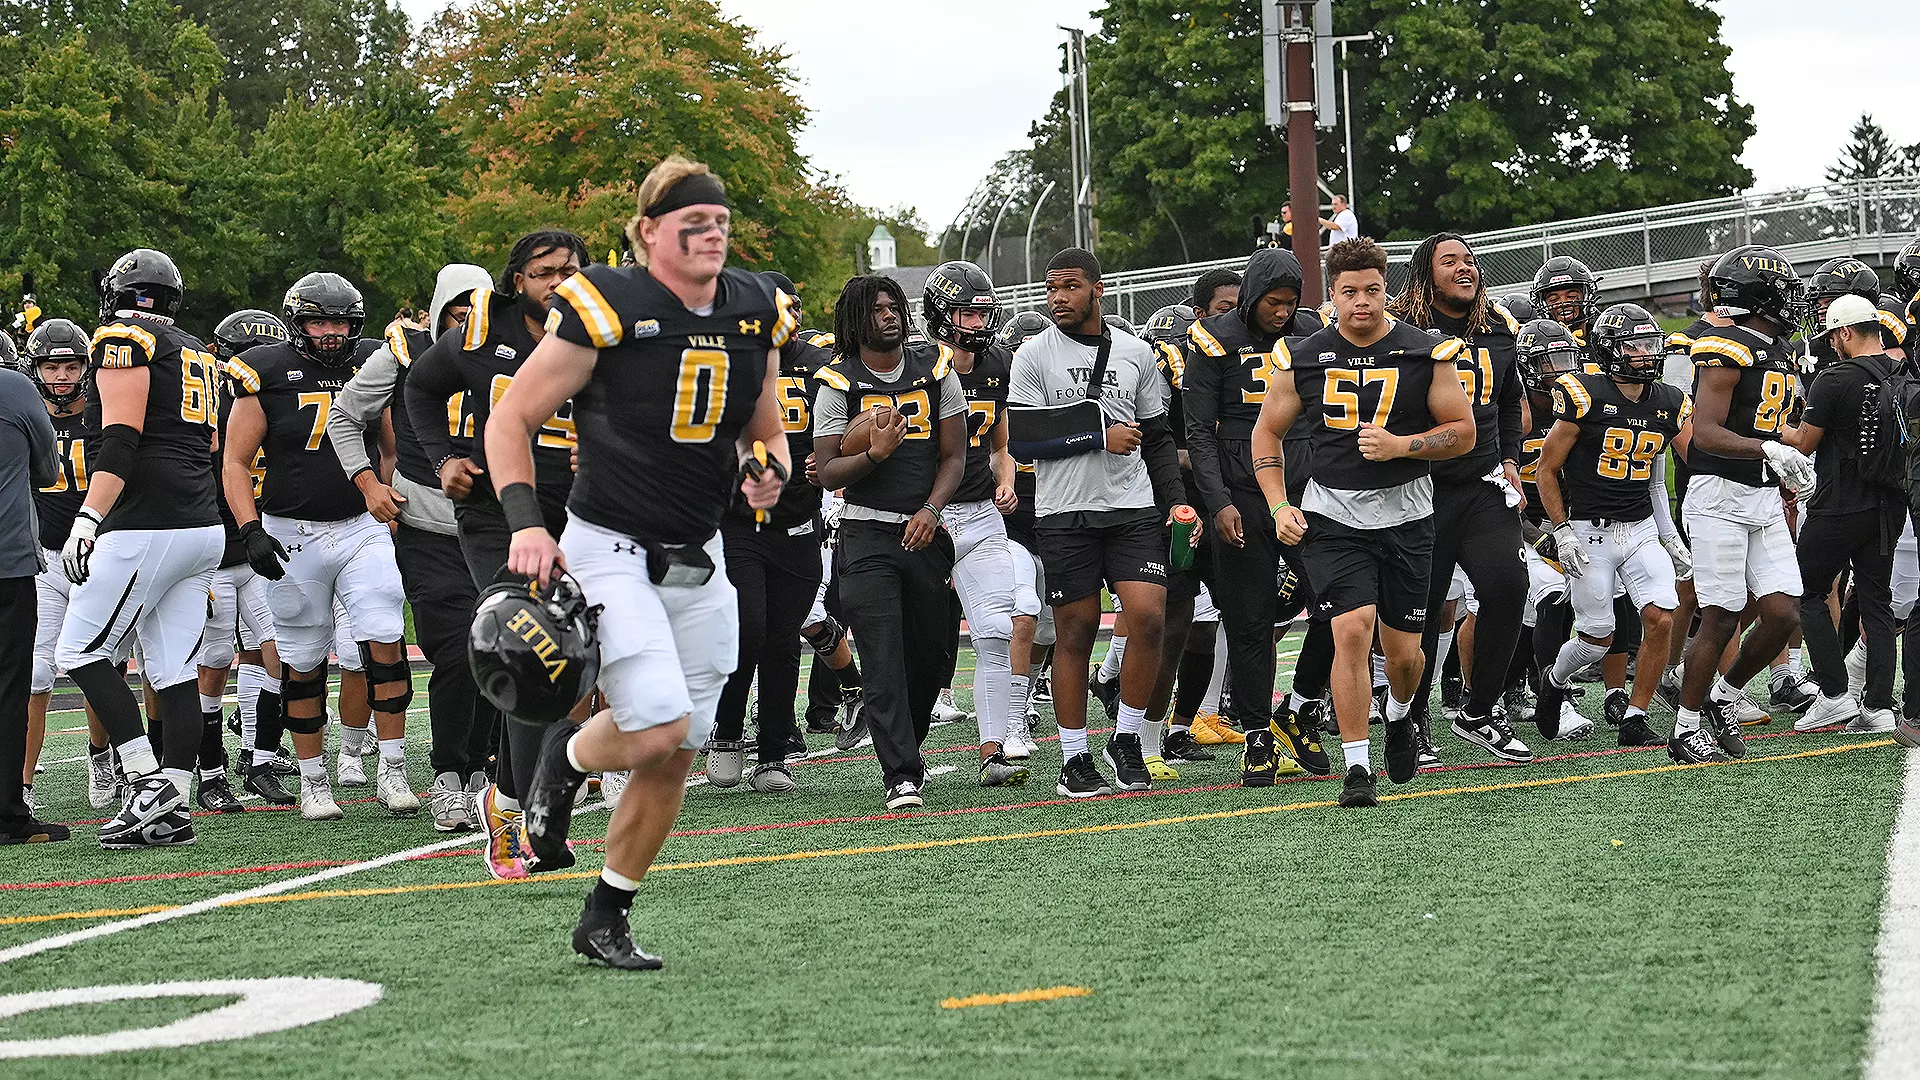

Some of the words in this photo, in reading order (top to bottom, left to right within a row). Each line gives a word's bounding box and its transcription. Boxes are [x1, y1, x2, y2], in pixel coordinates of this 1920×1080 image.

[1742, 256, 1789, 277] VILLE
[1831, 262, 1869, 278] VILL
[241, 321, 285, 342] VILLE
[687, 335, 727, 350] VILLE
[102, 343, 133, 369] 60
[1347, 356, 1376, 367] VILLE
[181, 345, 220, 430] 60
[317, 380, 343, 390] VILLE
[669, 348, 732, 444] 0
[1055, 386, 1130, 400] FOOALL
[1322, 367, 1400, 430] 57
[298, 391, 345, 450] 7
[1626, 418, 1649, 428] VILLE
[1597, 426, 1665, 481] 89
[1278, 570, 1299, 600] ILLE
[506, 608, 568, 684] VILLE
